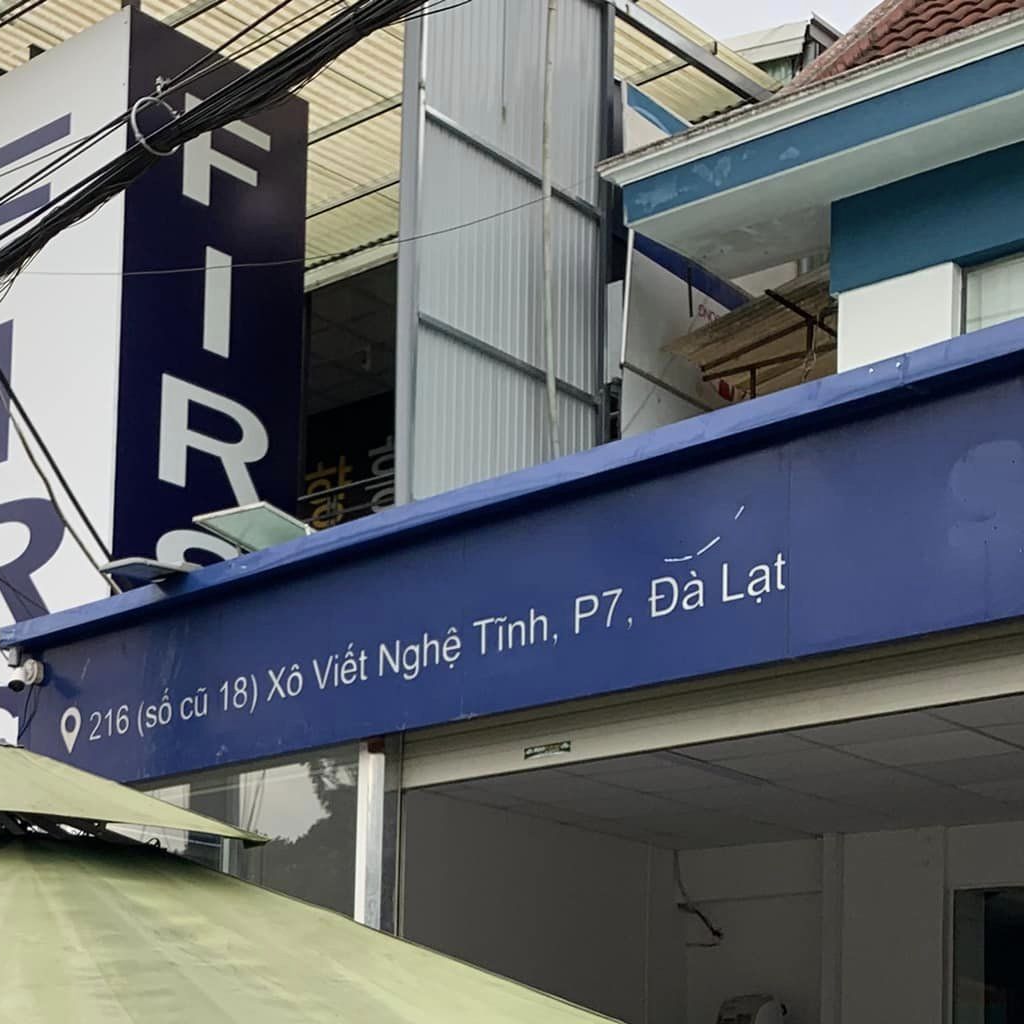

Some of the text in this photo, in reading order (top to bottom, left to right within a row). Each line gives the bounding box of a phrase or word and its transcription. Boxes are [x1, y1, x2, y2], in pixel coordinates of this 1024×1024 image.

[89, 552, 787, 741] 216 (số cũ 18) Xô Viết Nghệ Tĩnh, P7, Đà Lạt
